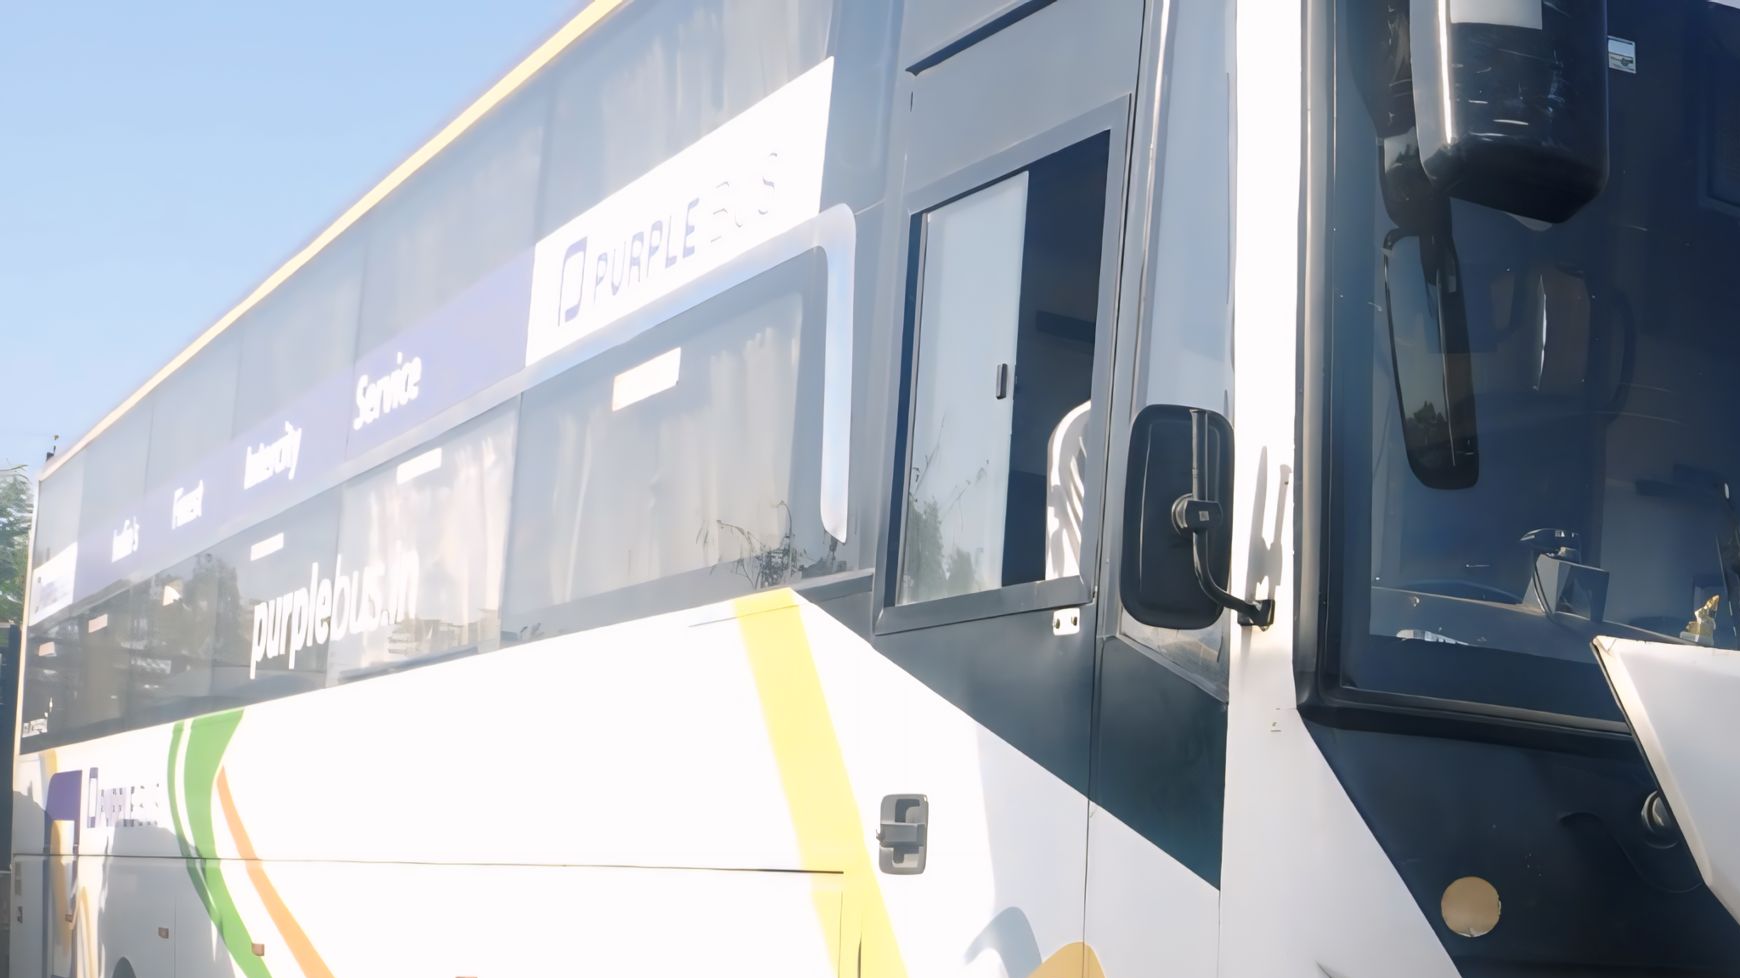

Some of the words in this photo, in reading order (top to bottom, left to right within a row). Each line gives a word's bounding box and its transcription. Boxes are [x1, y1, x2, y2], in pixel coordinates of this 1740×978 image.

[593, 195, 702, 305] PURPLE
[709, 151, 781, 244] BS
[353, 354, 423, 430] Service
